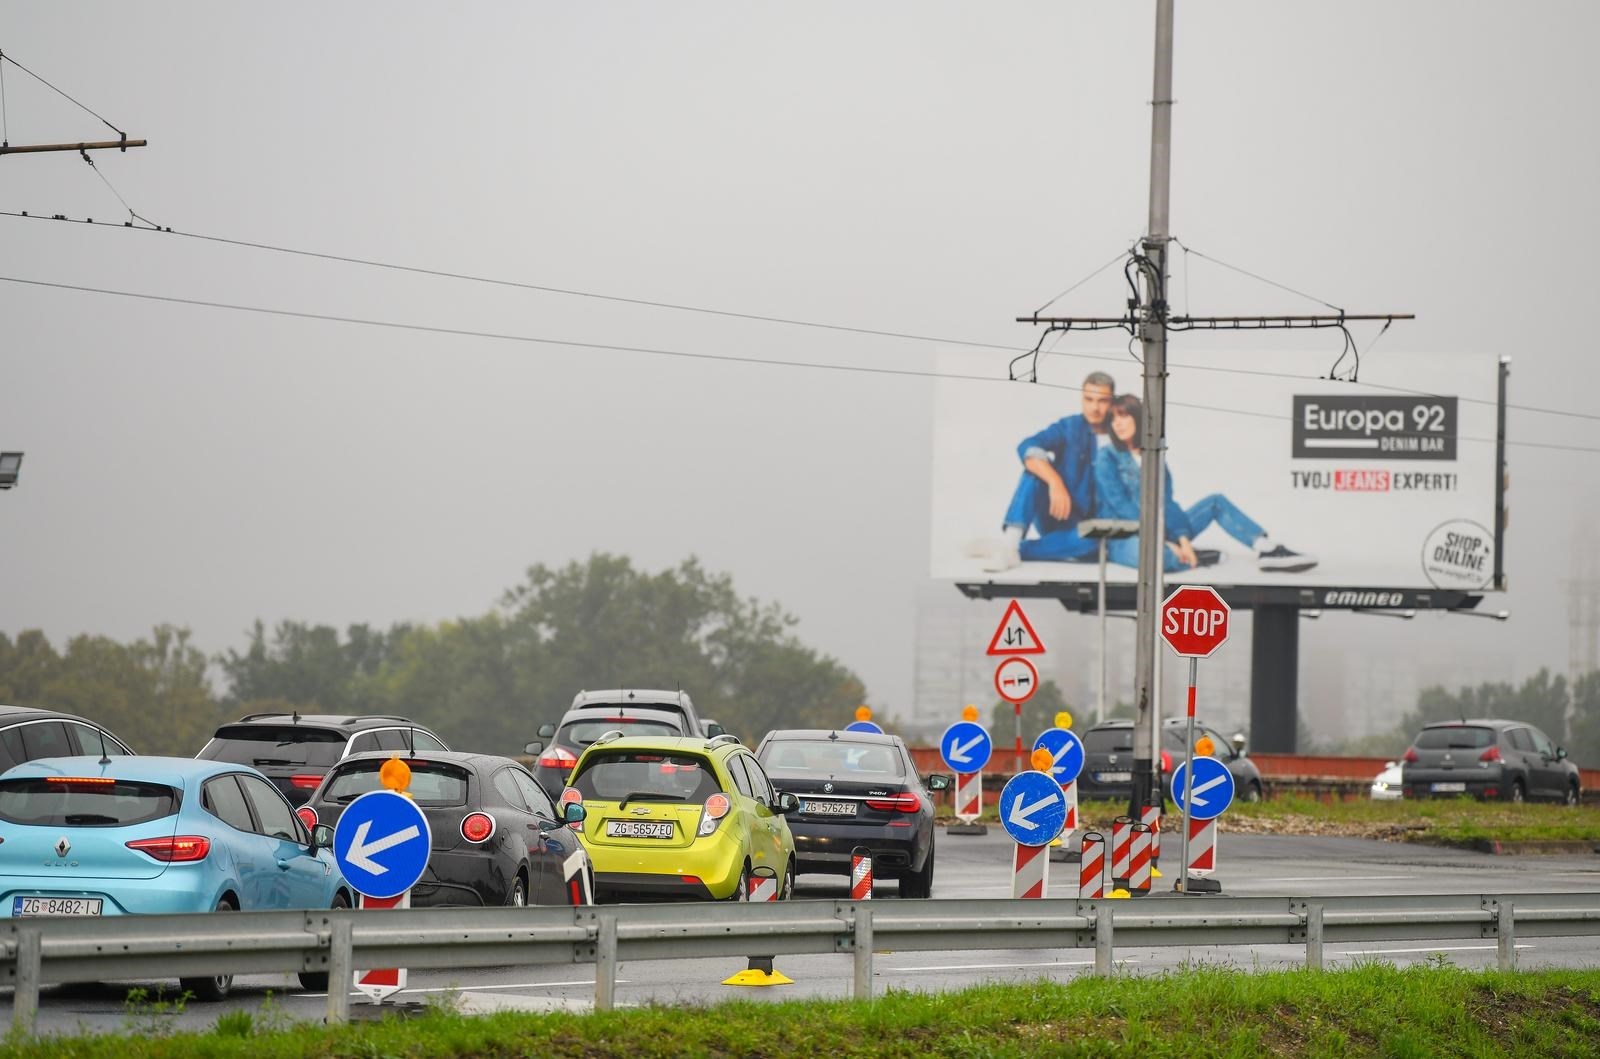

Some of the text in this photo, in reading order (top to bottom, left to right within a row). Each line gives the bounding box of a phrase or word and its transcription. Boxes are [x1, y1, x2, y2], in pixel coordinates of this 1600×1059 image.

[1304, 404, 1445, 435] Europa 92
[1381, 437, 1444, 452] DENIM BAR
[1291, 471, 1458, 491] TVOJ JEANS EXPERT!
[1445, 532, 1482, 552] SHOP
[1433, 546, 1485, 571] ONLINE
[1324, 591, 1404, 606] emineo
[1164, 607, 1225, 637] STOP
